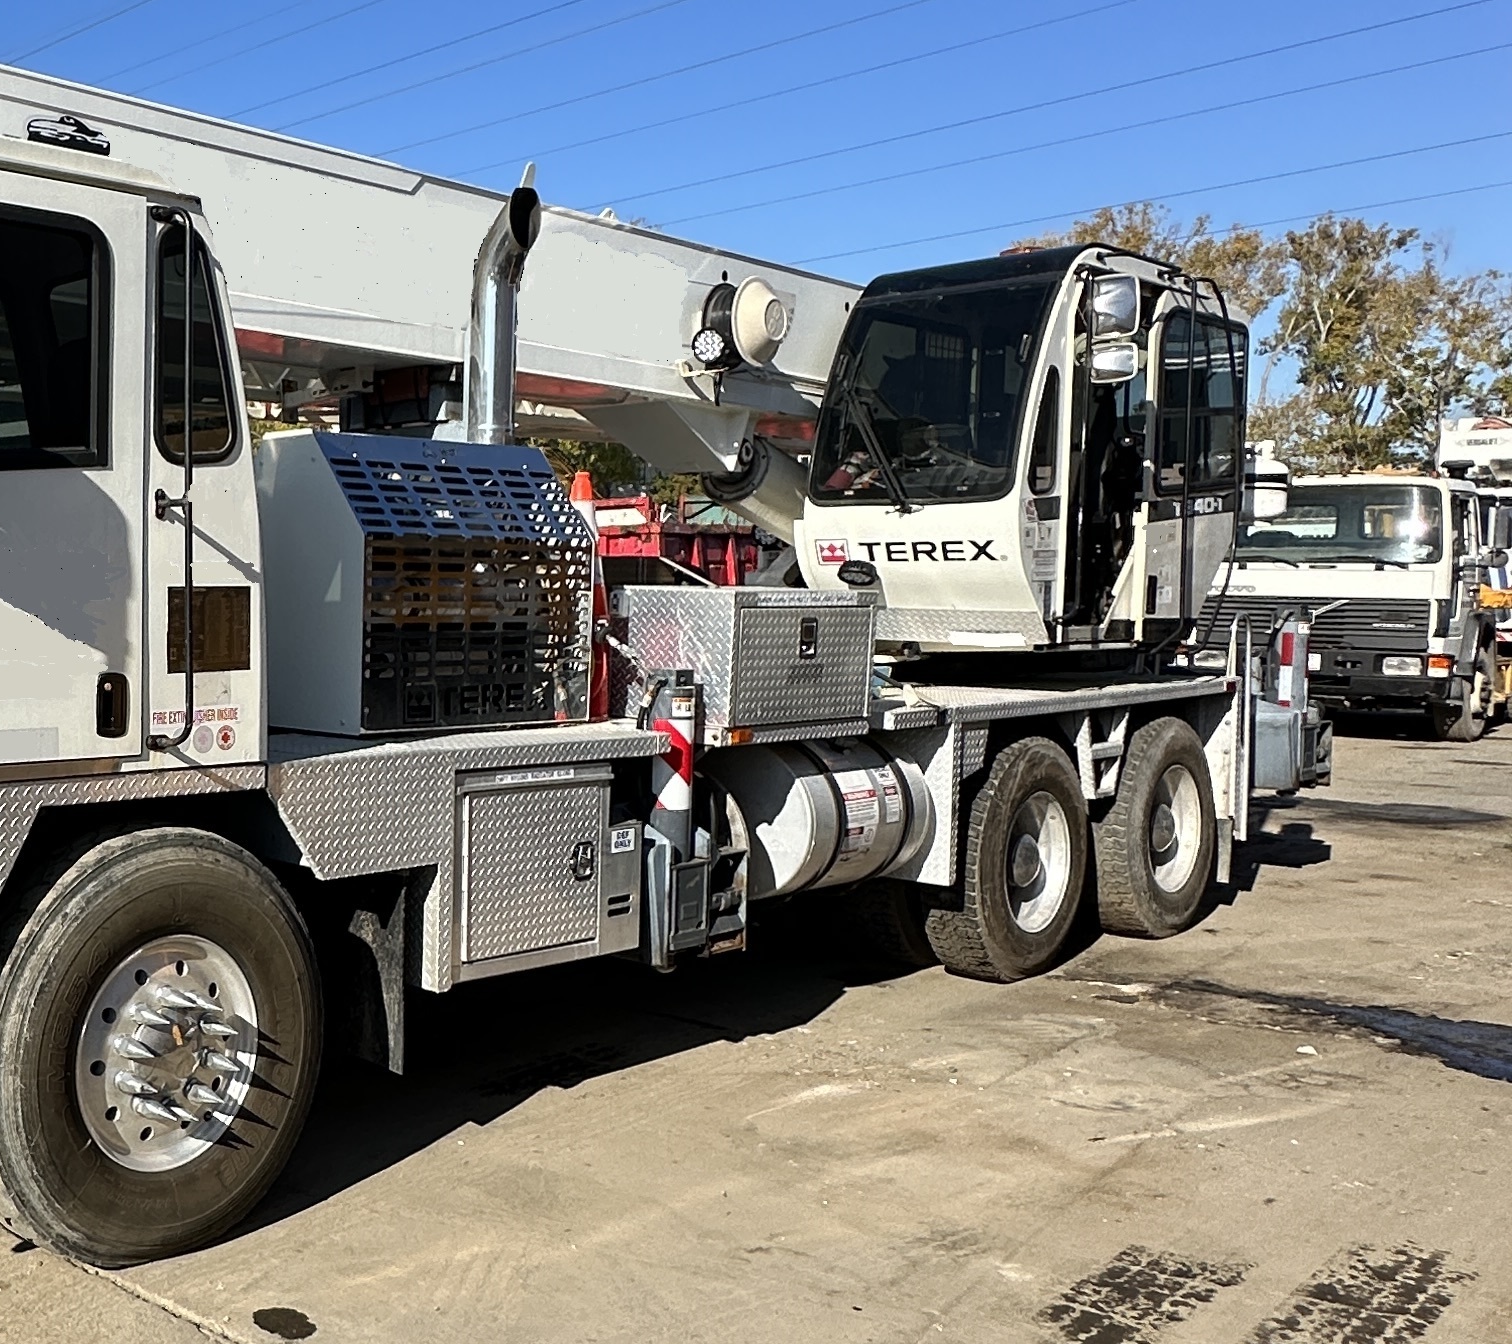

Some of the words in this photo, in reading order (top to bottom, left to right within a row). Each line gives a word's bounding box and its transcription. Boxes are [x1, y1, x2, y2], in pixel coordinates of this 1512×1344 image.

[857, 539, 999, 562] TEREX
[1210, 585, 1256, 593] VOVO
[441, 681, 549, 716] TEREX
[152, 711, 167, 725] FIRE
